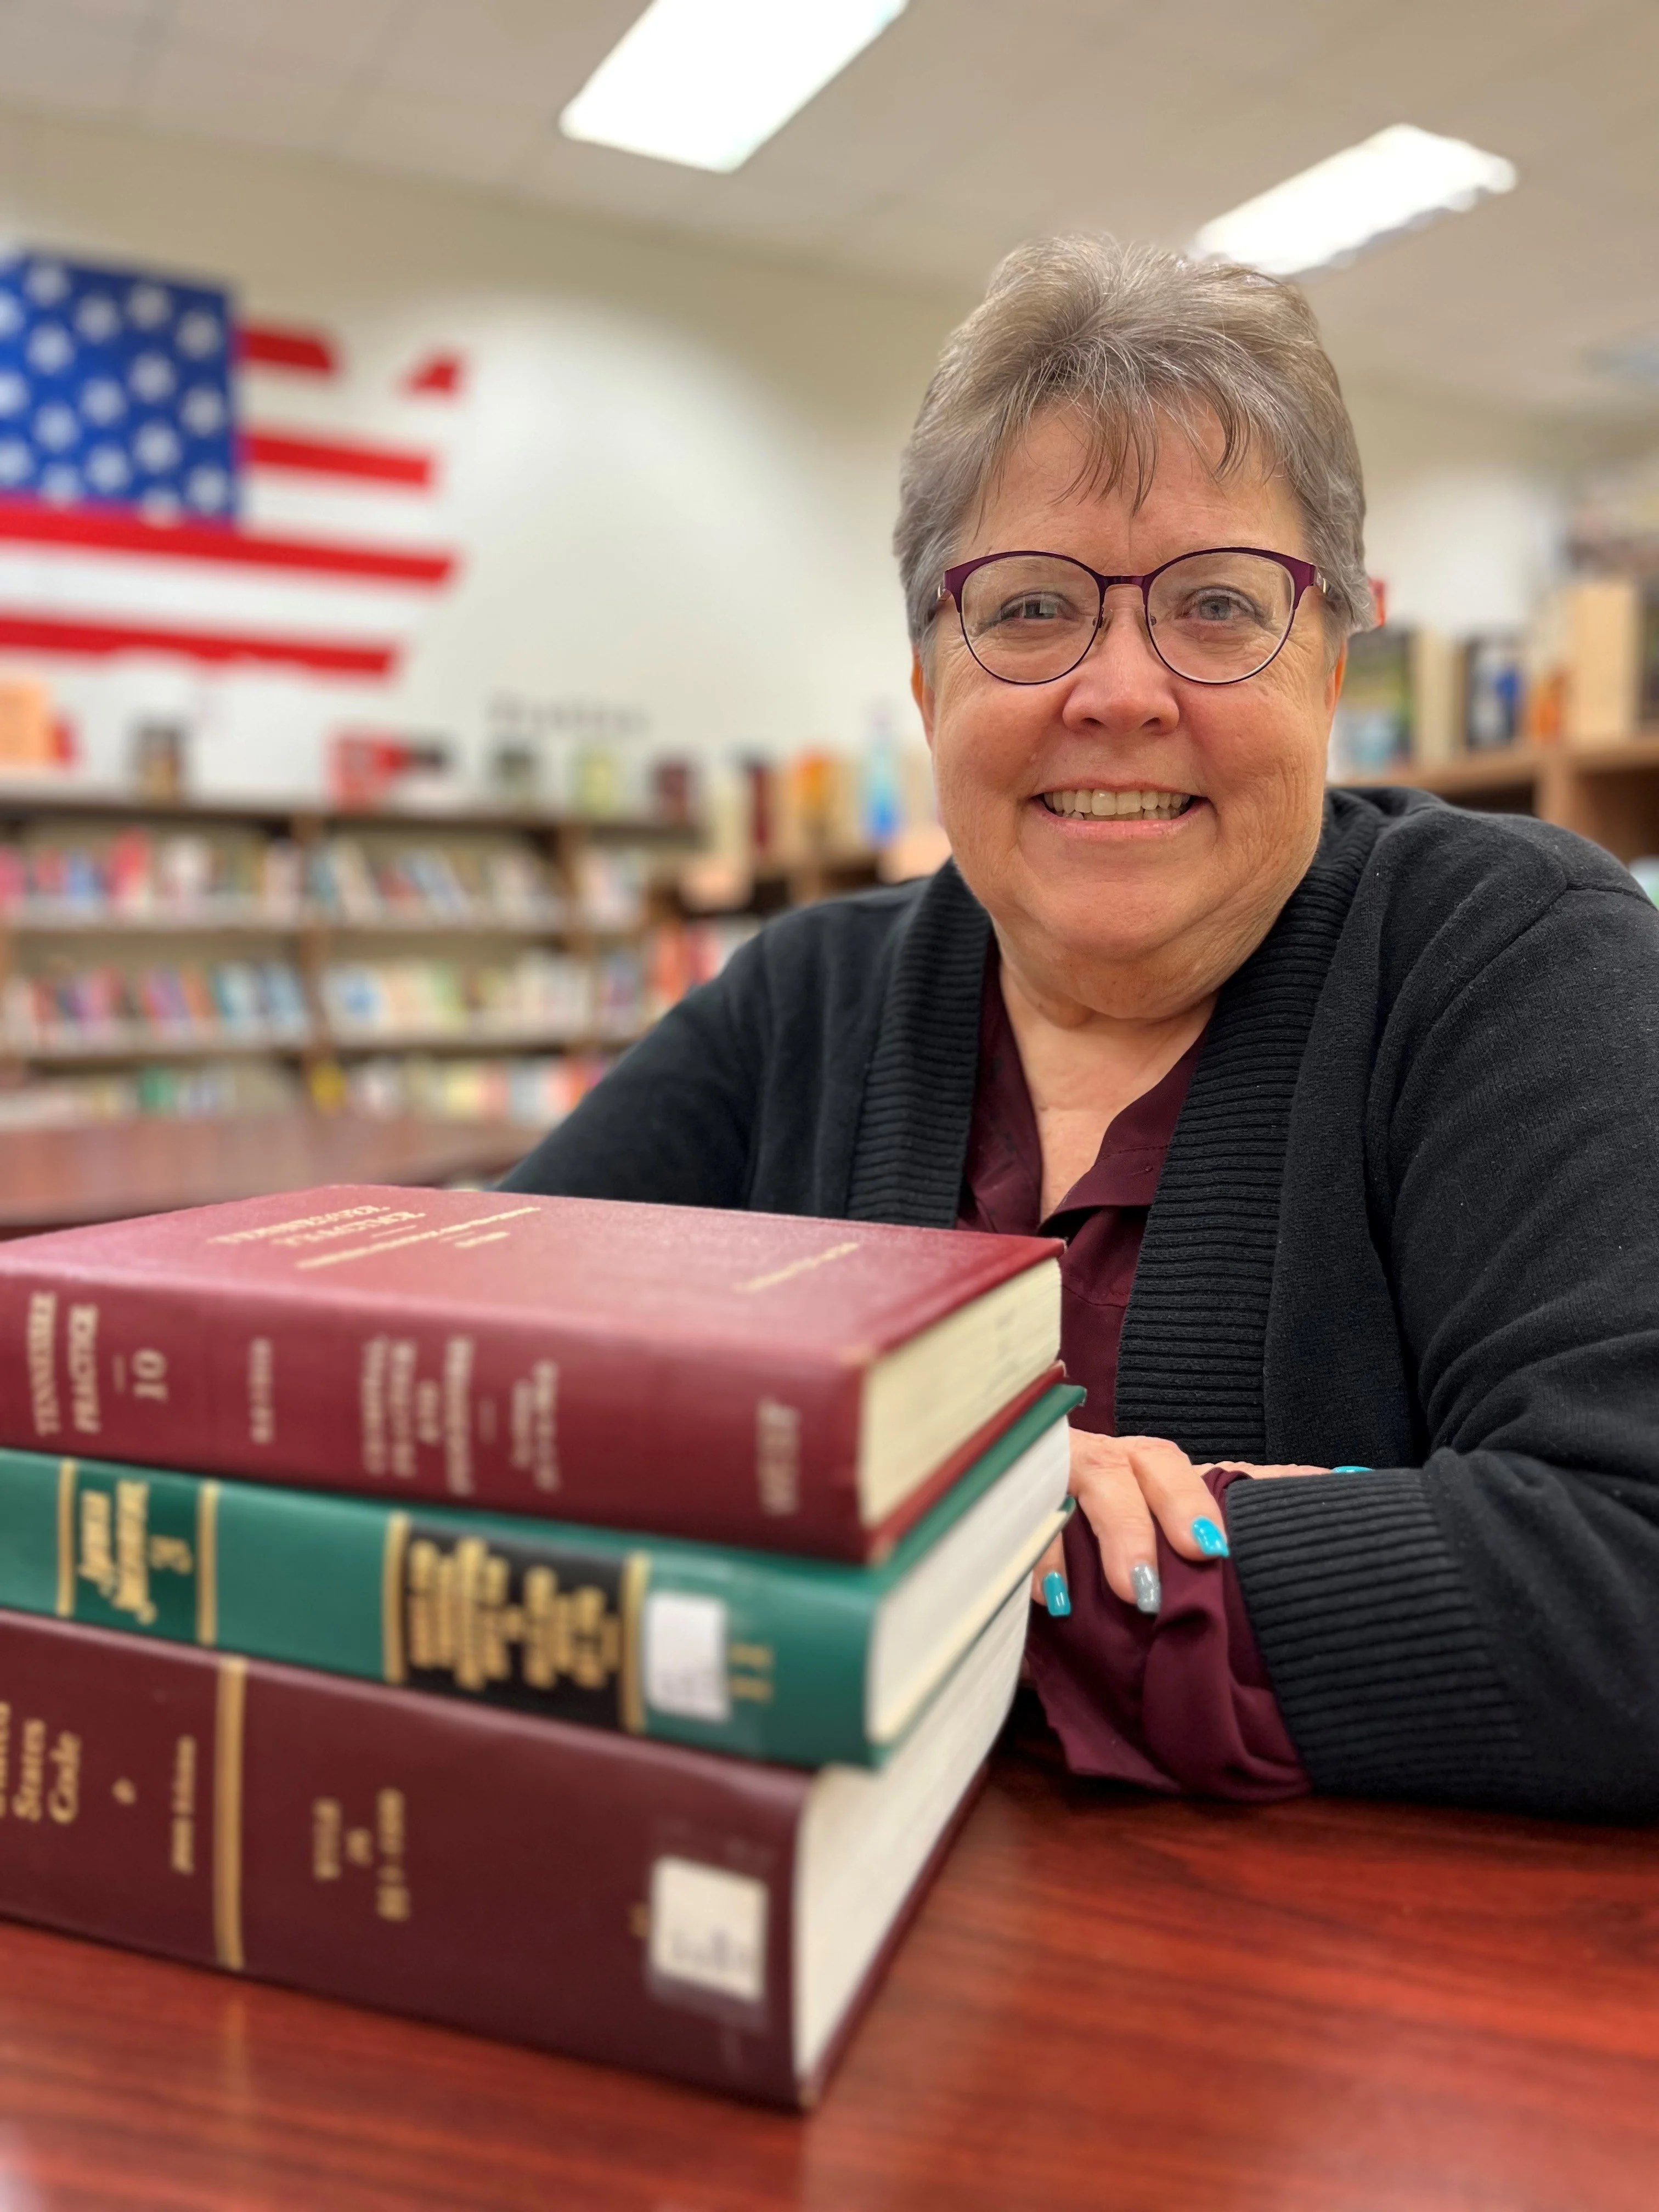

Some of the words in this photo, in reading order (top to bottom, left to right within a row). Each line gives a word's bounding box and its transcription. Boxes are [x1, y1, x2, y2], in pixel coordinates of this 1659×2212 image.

[132, 1349, 168, 1403] 10
[14, 1718, 46, 1822] States
[47, 1730, 81, 1824] Code
